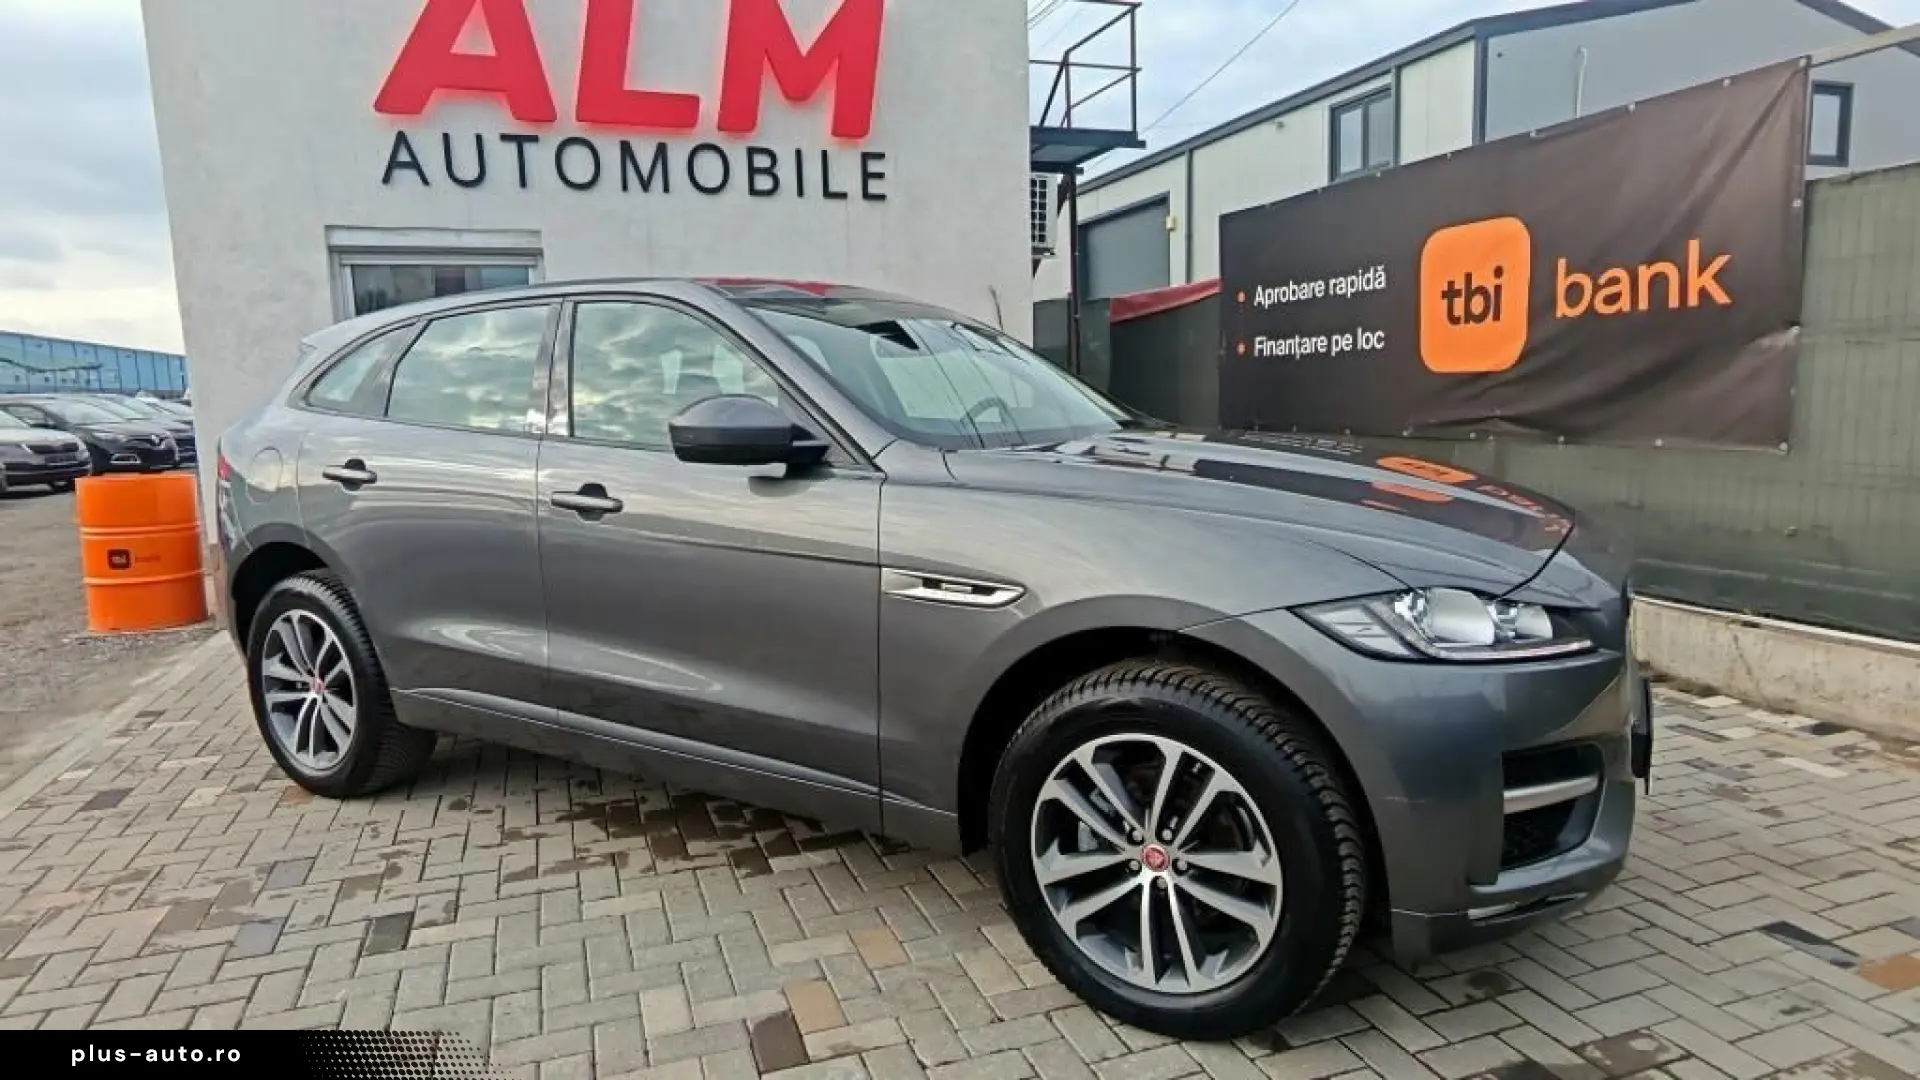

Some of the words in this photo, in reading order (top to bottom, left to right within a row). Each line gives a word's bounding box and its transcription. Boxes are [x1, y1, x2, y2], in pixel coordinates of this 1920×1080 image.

[374, 0, 884, 138] ALM
[382, 131, 888, 200] AUTOMOBILE
[1254, 280, 1325, 309] Aprobare
[1329, 265, 1386, 298] rapidă
[1441, 265, 1505, 326] tbi
[1555, 238, 1733, 319] bank
[1331, 333, 1353, 357] pe
[1356, 326, 1385, 350] loc
